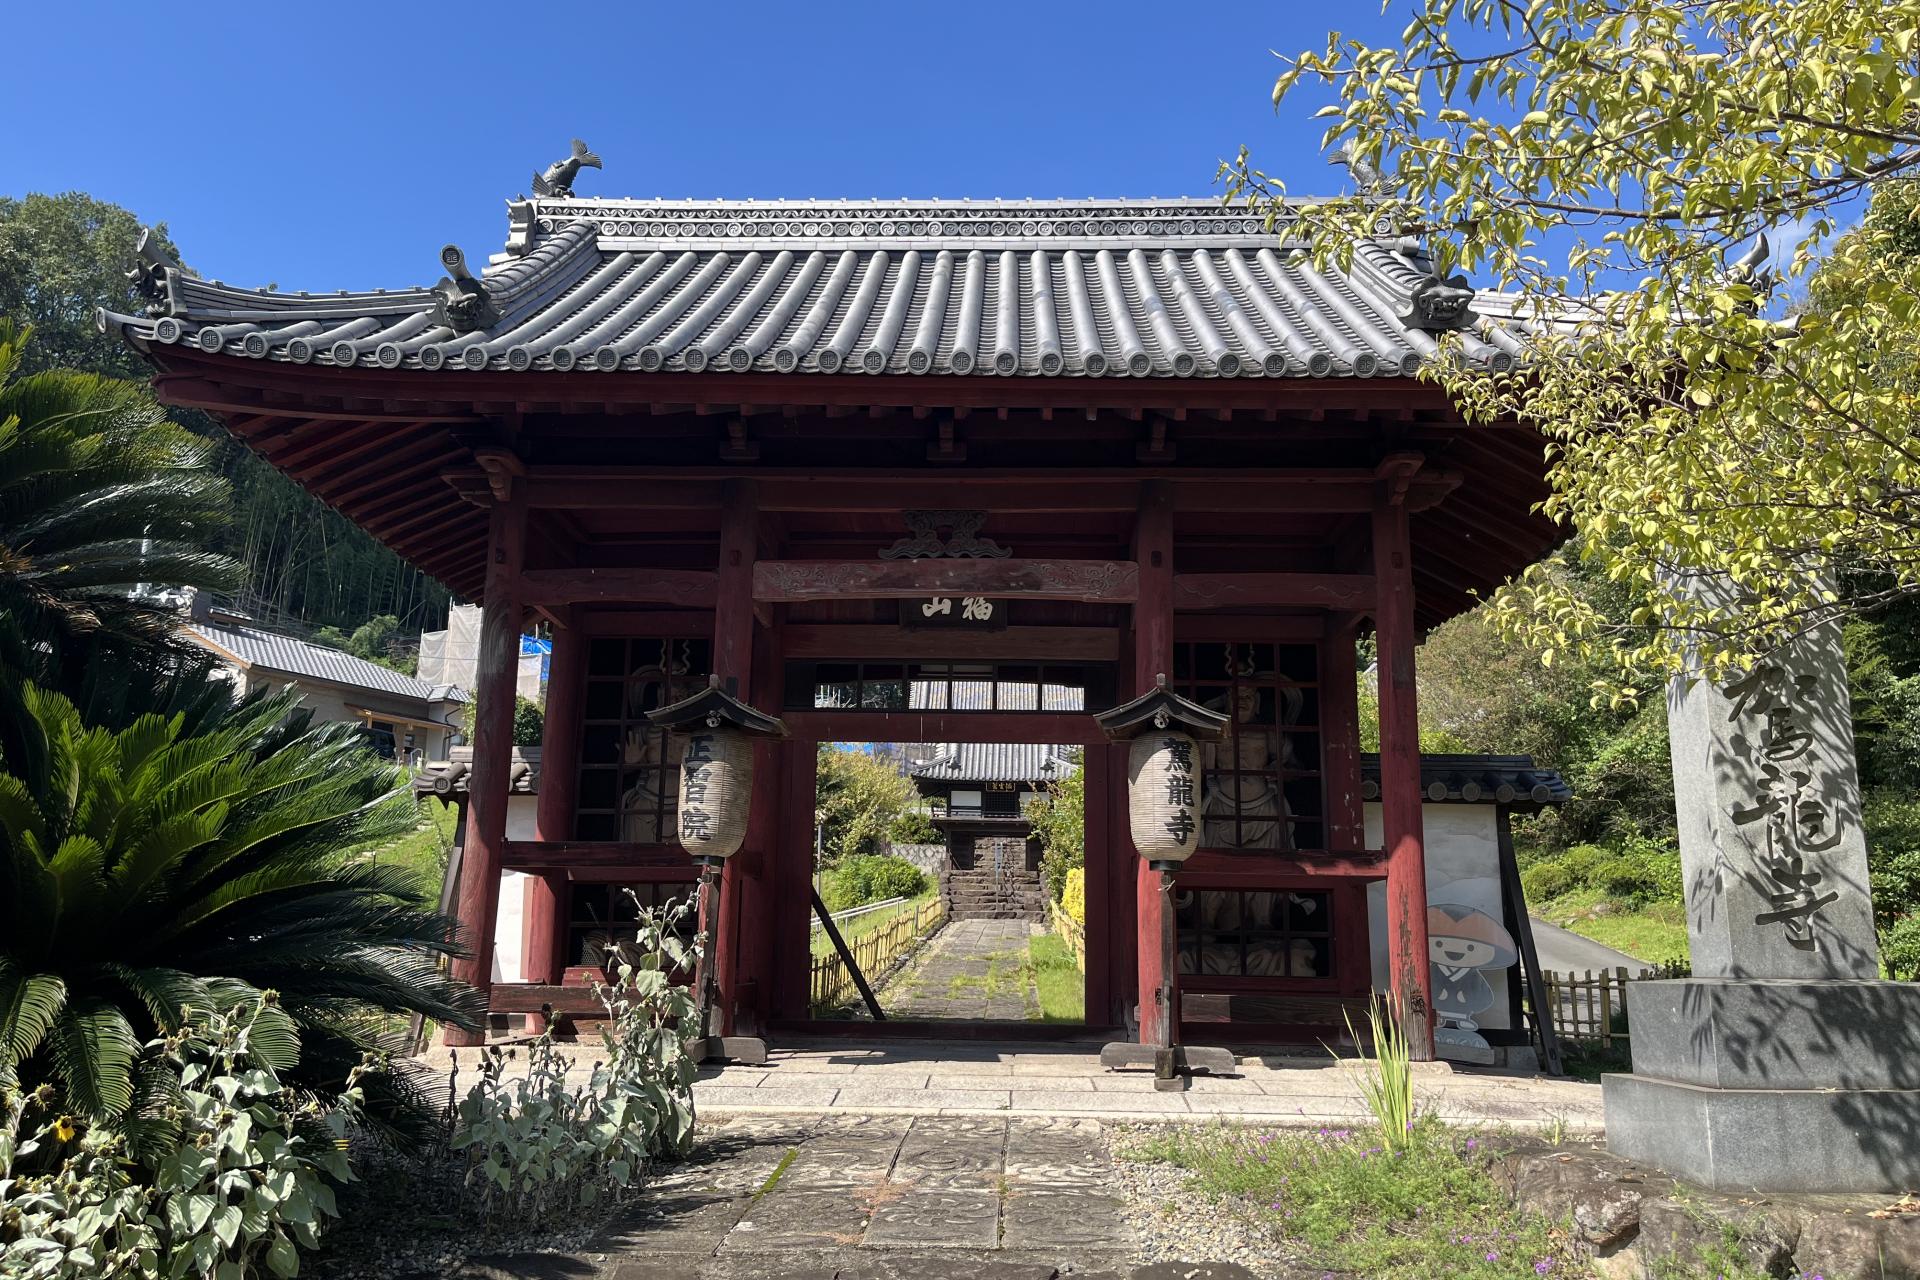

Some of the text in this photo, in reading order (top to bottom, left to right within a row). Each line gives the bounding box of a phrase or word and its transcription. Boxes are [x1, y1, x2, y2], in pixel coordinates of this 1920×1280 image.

[682, 734, 714, 841] 正智院
[1163, 737, 1196, 846] 駕龍寺
